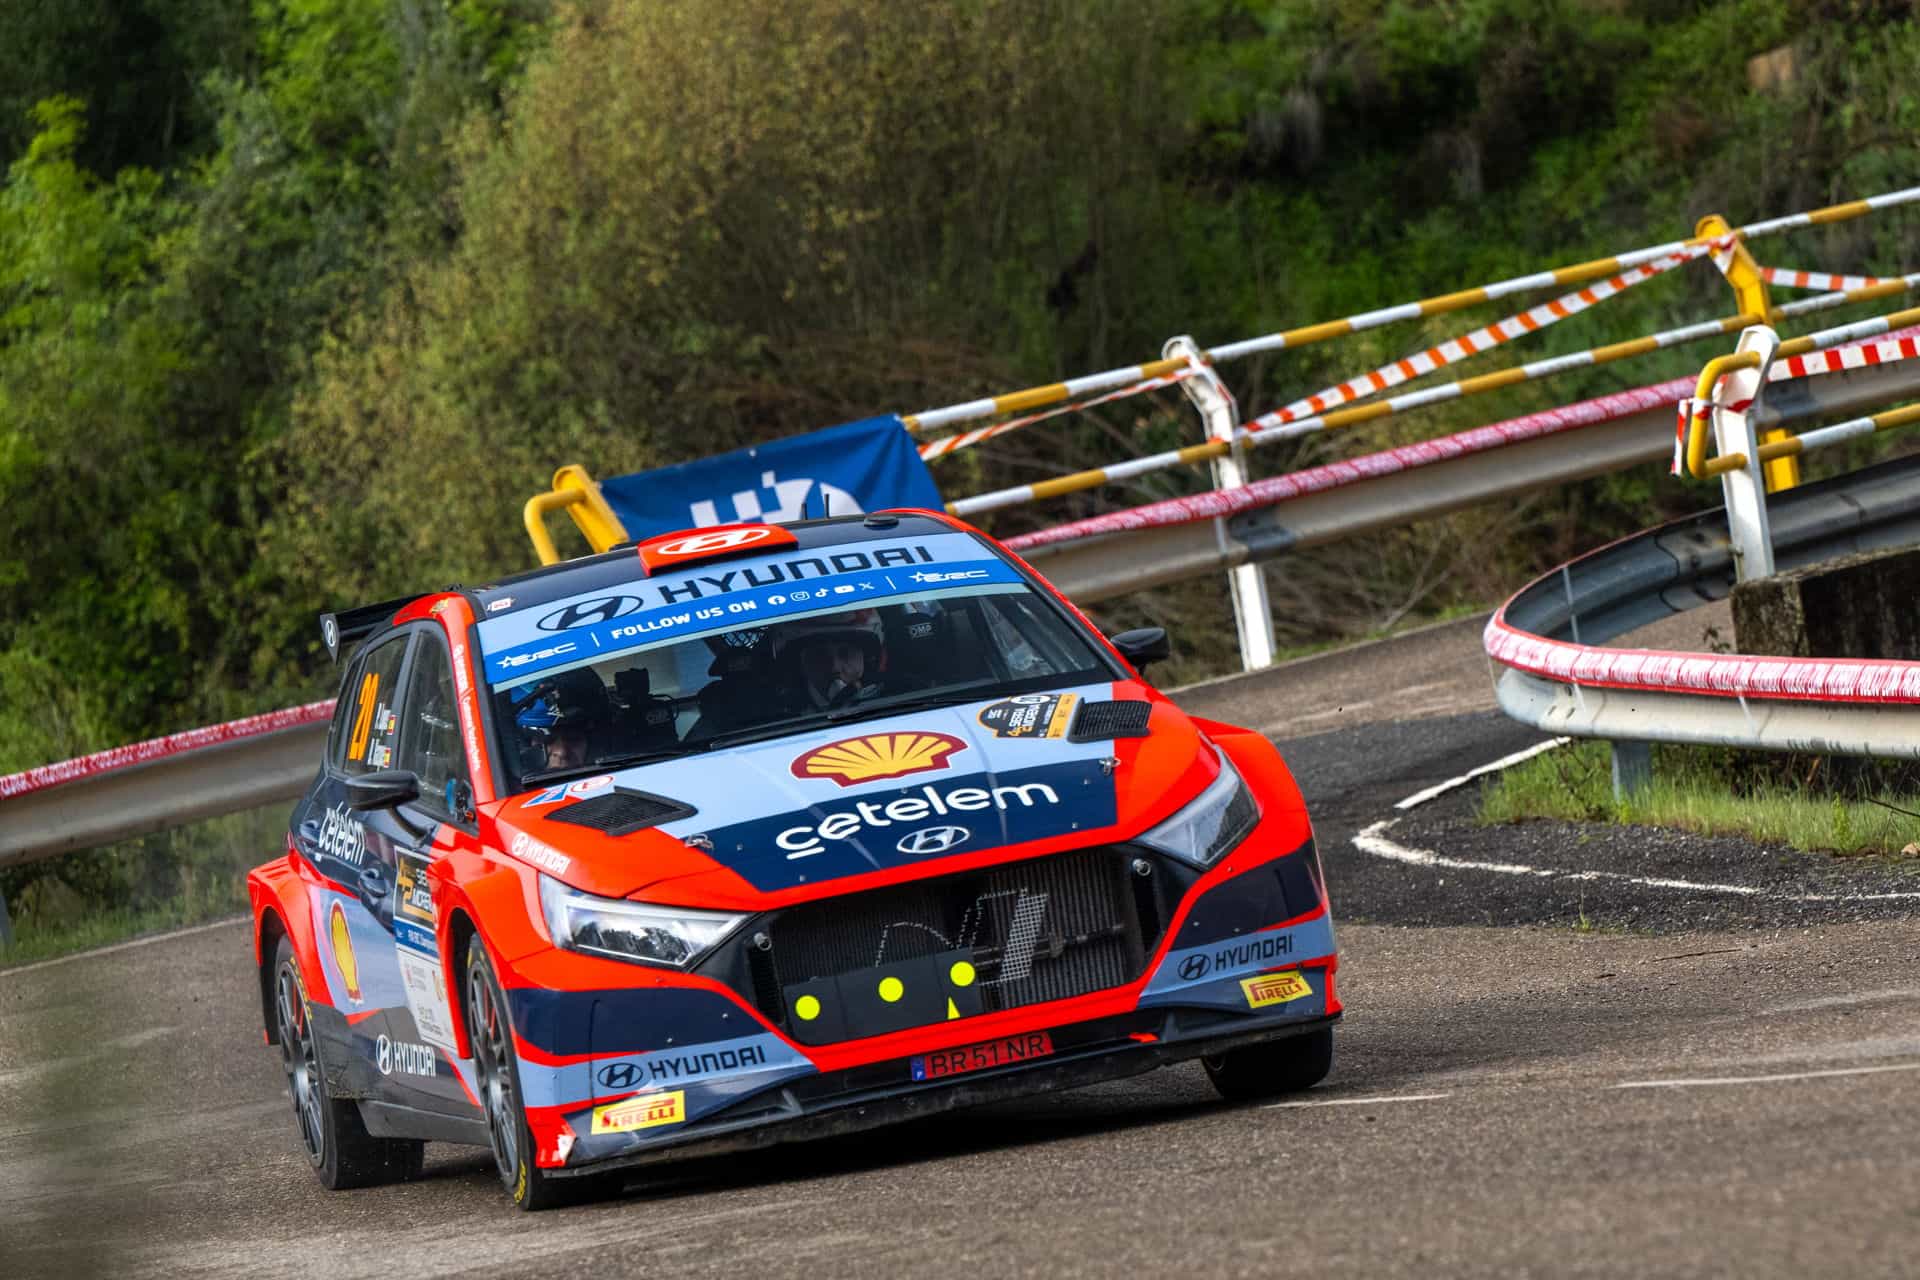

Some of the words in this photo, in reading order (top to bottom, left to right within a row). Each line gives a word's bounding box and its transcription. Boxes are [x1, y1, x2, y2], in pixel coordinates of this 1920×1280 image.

[658, 546, 935, 604] HYUNDAI
[611, 612, 691, 640] FOLLOW
[697, 606, 725, 620] US
[729, 600, 757, 613] ON
[319, 801, 366, 866] cetelem
[775, 783, 1060, 860] cetelem
[1215, 934, 1293, 971] HYUNDAI
[1248, 976, 1304, 1002] PIRELLI
[393, 1040, 437, 1077] HYUNDAI
[648, 1046, 766, 1080] HYUNDAI
[931, 1051, 966, 1075] BR
[972, 1043, 998, 1067] 51
[1007, 1034, 1045, 1059] NR
[600, 1098, 676, 1128] PIRELLI
